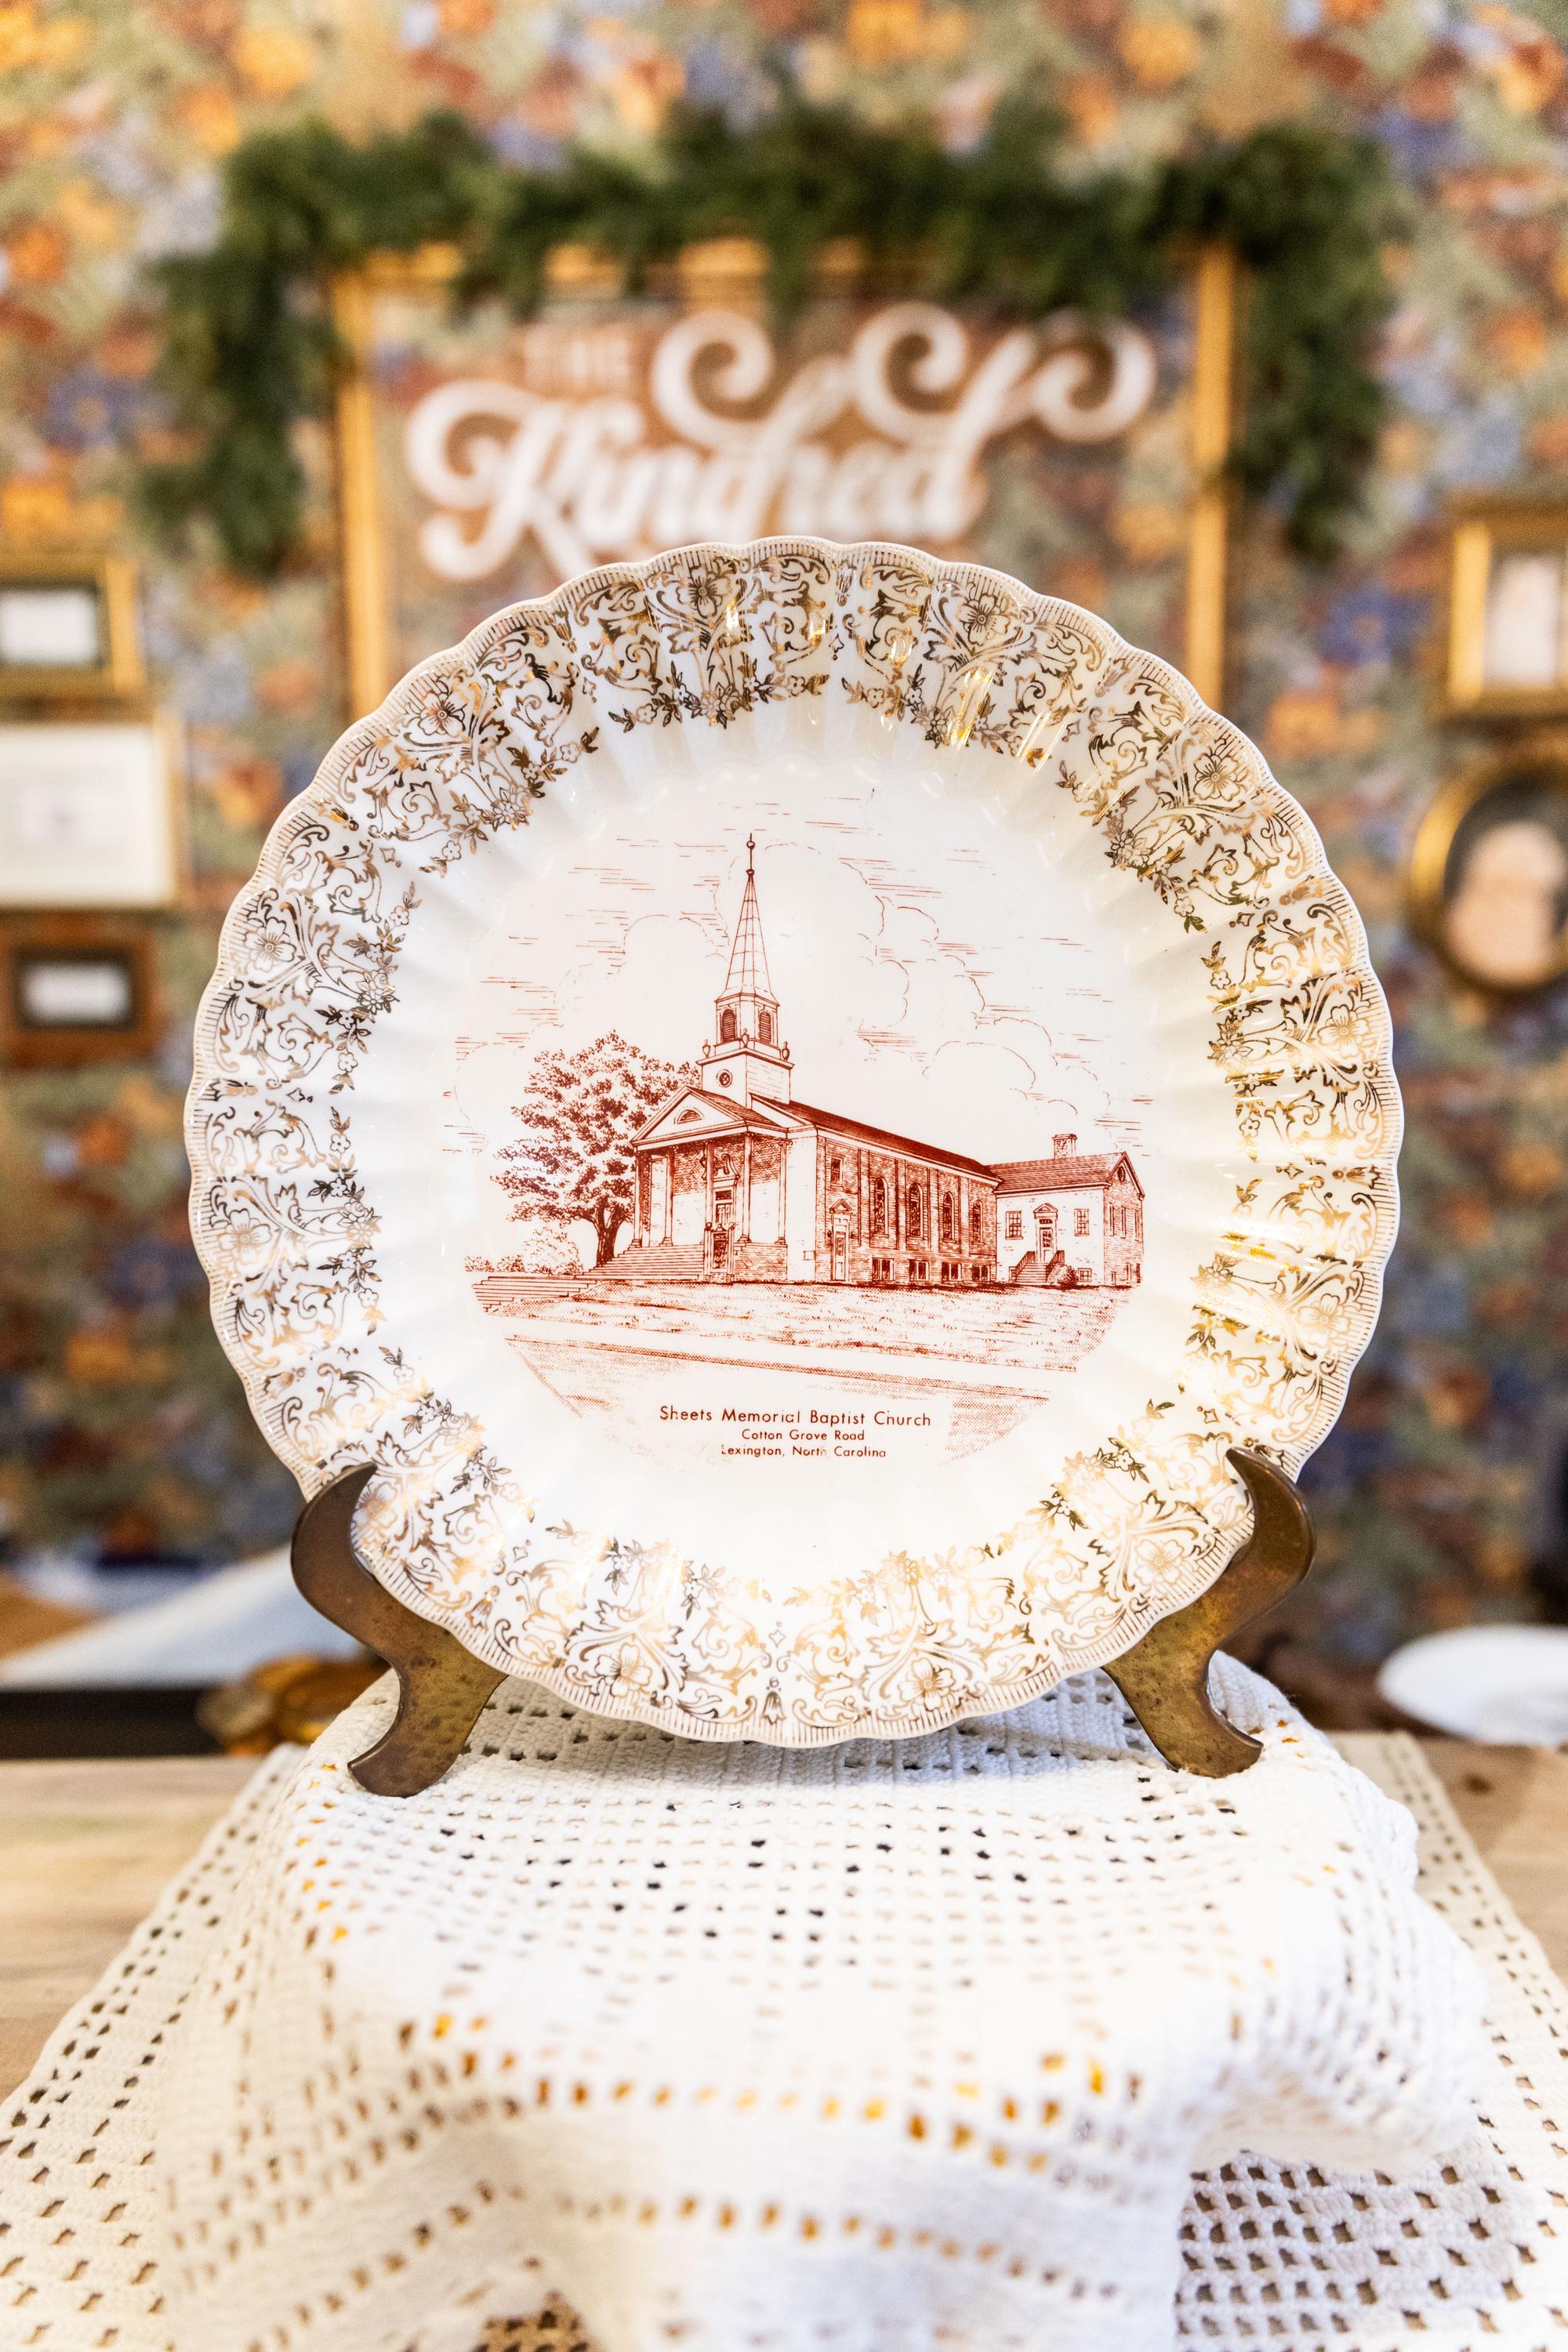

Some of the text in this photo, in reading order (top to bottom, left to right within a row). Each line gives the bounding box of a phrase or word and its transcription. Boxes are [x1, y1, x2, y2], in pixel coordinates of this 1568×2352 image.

[524, 329, 633, 389] THE
[405, 303, 1157, 581] Kindred
[659, 1404, 931, 1427] Sheets Memorial Baptist Church
[741, 1428, 865, 1441] Cotton Grove Road
[720, 1443, 886, 1458] Lexington, North Carolina
